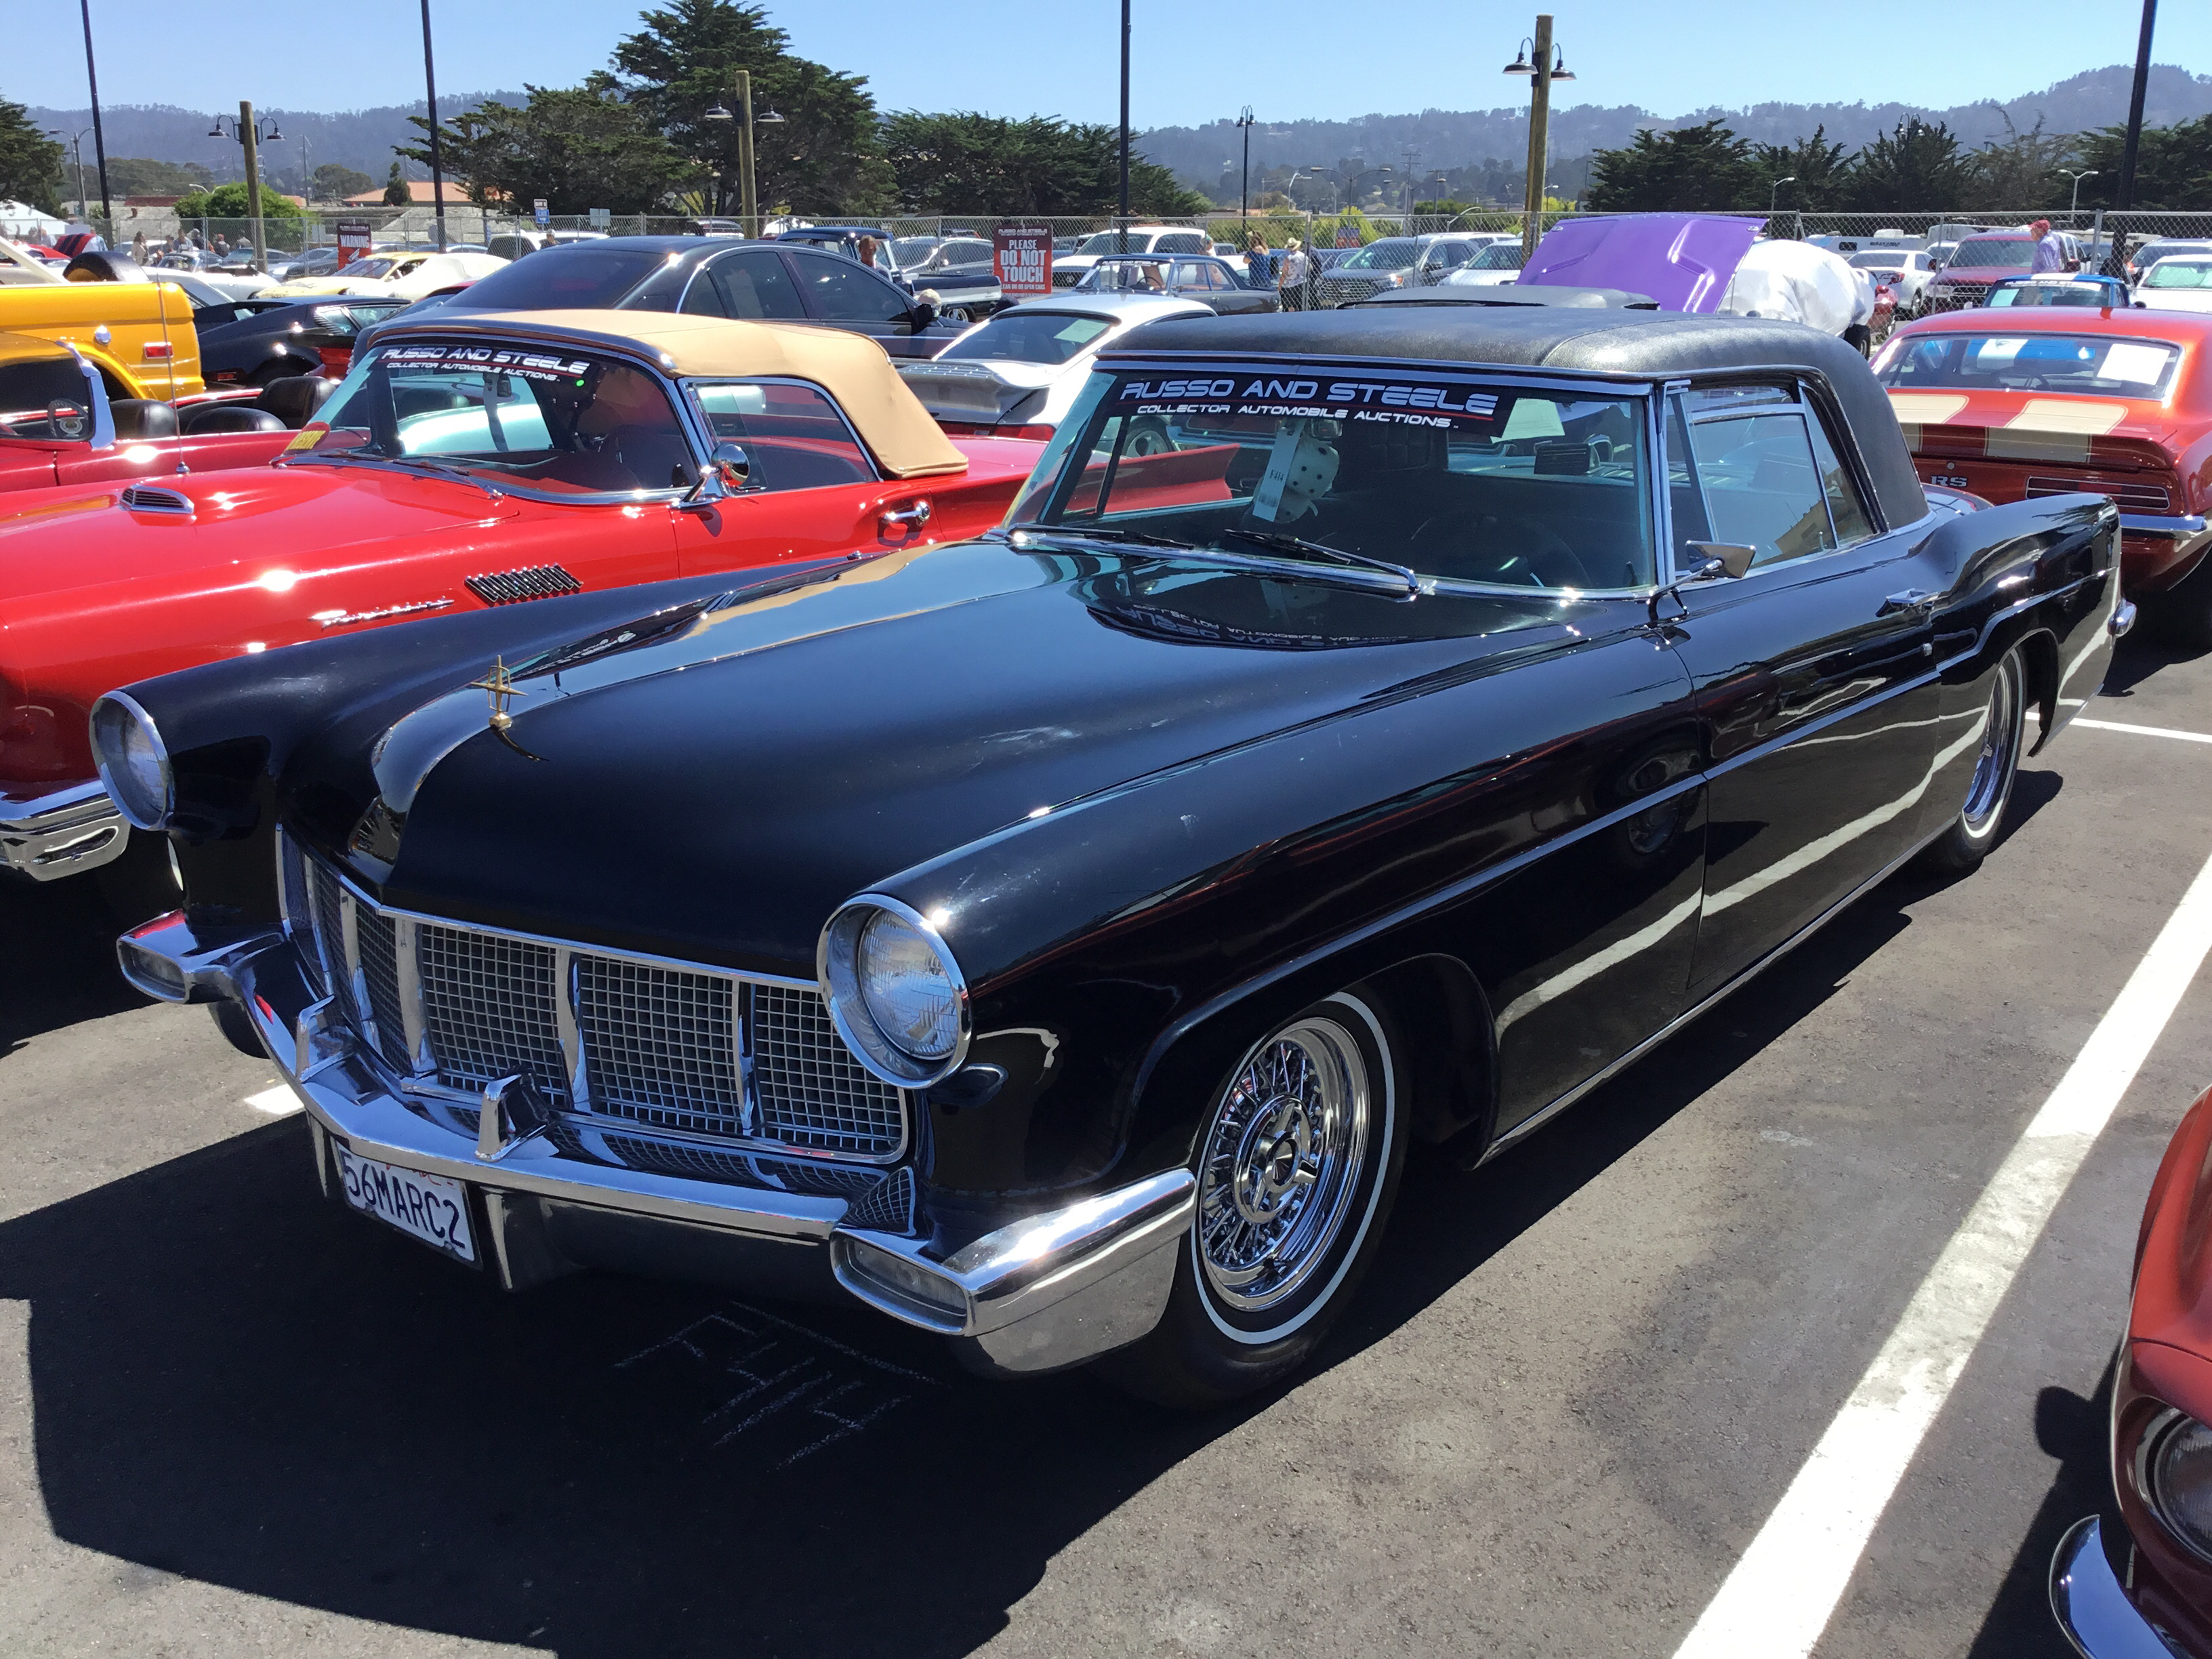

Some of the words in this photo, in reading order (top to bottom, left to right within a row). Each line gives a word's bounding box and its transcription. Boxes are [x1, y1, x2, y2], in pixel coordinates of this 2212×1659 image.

[340, 234, 369, 249] WARNING
[1008, 239, 1038, 249] PLEASE
[1000, 249, 1018, 266] DO
[1021, 249, 1046, 266] NOT
[1002, 266, 1044, 283] TOUCH
[382, 347, 447, 360] RUSSO
[447, 347, 493, 361] AND
[493, 350, 590, 374] STEELE
[440, 363, 503, 373] AUTOMOBILE
[503, 368, 558, 382] AUCTIONS
[1120, 380, 1235, 400] RUSSO
[1242, 380, 1318, 400] AND
[1326, 382, 1499, 415] STEELE
[1136, 405, 1231, 415] COLLECTOR
[1237, 405, 1347, 419] AUTOMOBILE
[1354, 411, 1452, 428] AUCTIONS
[1269, 469, 1285, 482] F414
[1931, 476, 1967, 487] RS
[340, 1150, 466, 1250] 56MARC2
